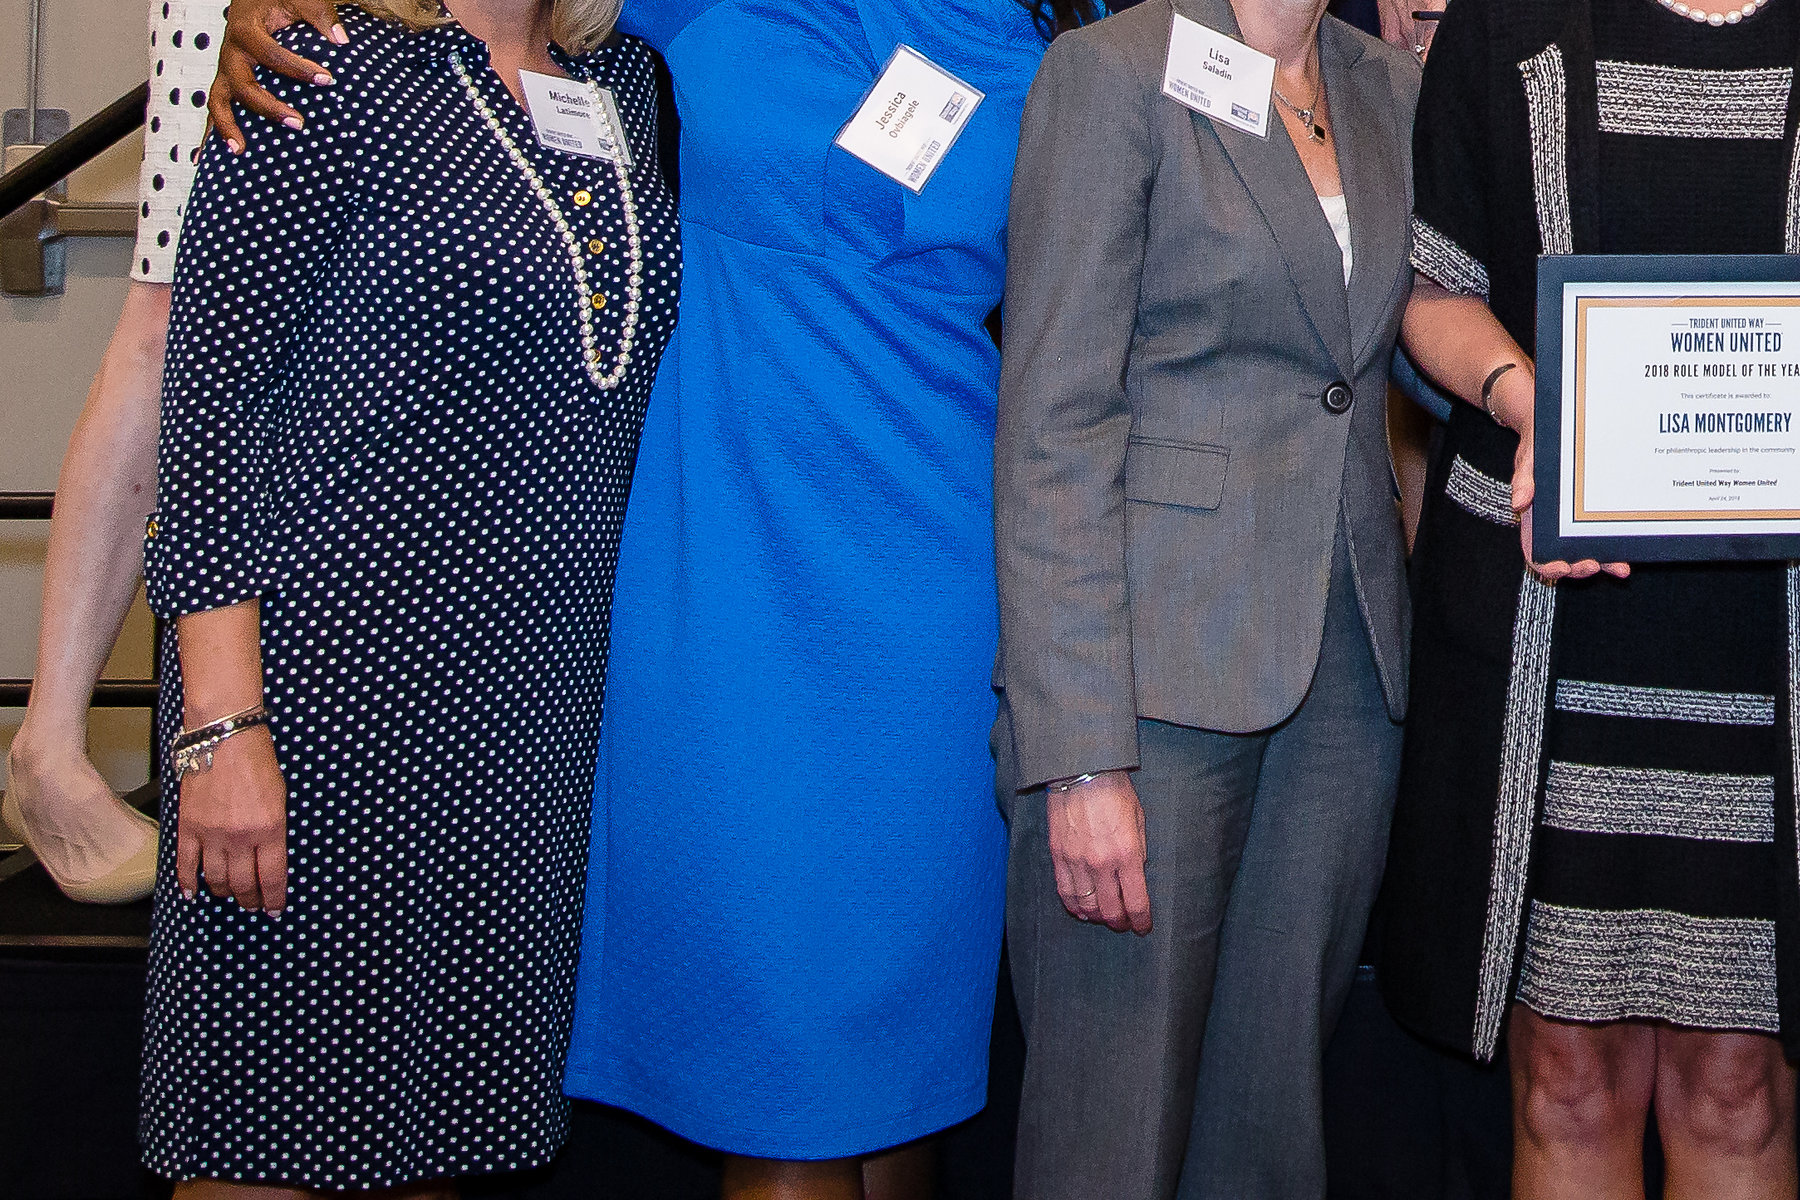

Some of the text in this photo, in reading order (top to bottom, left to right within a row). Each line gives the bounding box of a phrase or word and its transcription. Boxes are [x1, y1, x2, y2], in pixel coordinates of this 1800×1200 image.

[1209, 47, 1230, 66] Lisa
[1202, 61, 1232, 81] Saladin
[548, 90, 591, 108] Michelle
[875, 91, 906, 131] Jessica
[1689, 318, 1765, 329] TRIDENT UNITED WAY
[1671, 332, 1782, 352] WOMEN UNITED
[1645, 364, 1669, 377] 2018
[1674, 364, 1699, 377] ROLE
[1703, 364, 1737, 377] MODEL
[1742, 364, 1754, 377] OF
[1758, 364, 1777, 377] THE
[1659, 412, 1792, 434] LISA MONTGOMERY
[1708, 447, 1741, 455] leadership
[1672, 479, 1695, 487] Trident
[1718, 480, 1731, 488] Way
